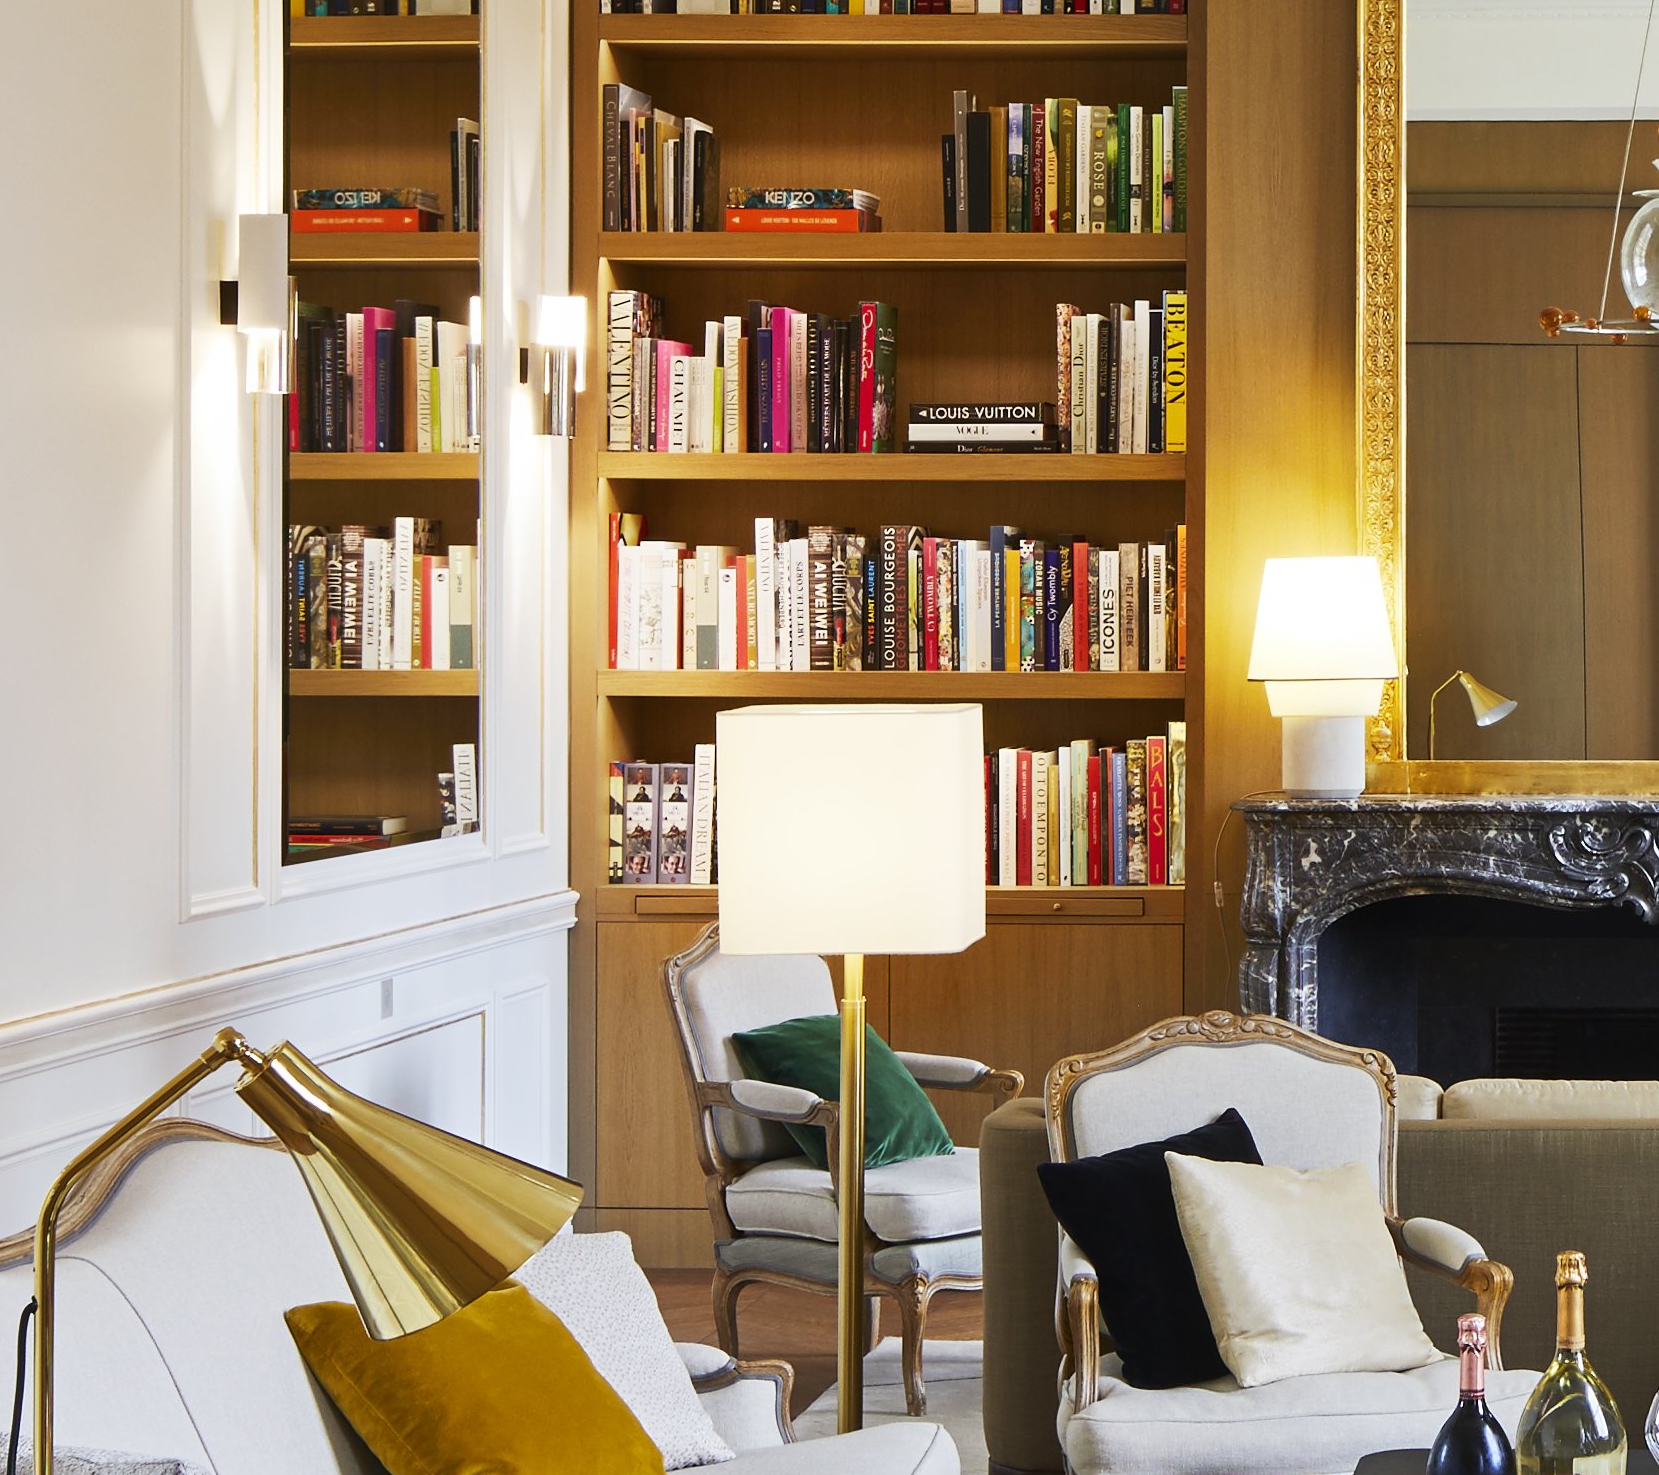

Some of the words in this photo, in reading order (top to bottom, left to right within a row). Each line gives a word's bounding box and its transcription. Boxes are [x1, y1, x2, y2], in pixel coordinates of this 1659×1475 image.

[606, 101, 616, 149] CHEVAL
[1033, 119, 1043, 134] The
[1177, 93, 1187, 154] HAMPTONS
[1033, 136, 1043, 155] New
[606, 156, 616, 198] BLANC
[1033, 158, 1043, 184] English
[1093, 151, 1105, 190] ROSE
[1177, 157, 1187, 209] GARDENS
[765, 191, 816, 205] KENZO
[1033, 186, 1043, 216] Garden
[611, 299, 631, 419] VALENTINO
[823, 361, 831, 370] LA
[1073, 343, 1084, 367] Dior
[1166, 303, 1185, 404] BEATON
[672, 359, 685, 450] CHAUMET
[726, 379, 739, 434] FASHION
[929, 406, 970, 420] LOUIS
[974, 406, 1036, 420] VUITTON
[1073, 371, 1084, 417] Christian
[956, 426, 989, 436] VOGUE
[957, 445, 973, 453] Dior
[760, 525, 771, 592] VALENTINO
[814, 561, 828, 578] AI
[884, 527, 895, 612] BOURGEOIS
[896, 527, 906, 580] INTIMES
[1035, 560, 1043, 586] ZORAN
[797, 594, 804, 603] LE
[832, 568, 847, 611] MUCHA
[1035, 589, 1043, 615] MUSIC
[1047, 566, 1058, 606] Twombly
[1125, 576, 1133, 598] PIET
[797, 609, 804, 619] ET
[814, 583, 828, 645] WEIWEI
[994, 620, 1000, 628] LA
[1047, 609, 1058, 621] Cy
[1102, 589, 1115, 655] ICONES
[1125, 601, 1133, 625] HEIN
[884, 618, 895, 669] LOUISE
[1125, 628, 1133, 647] EEK
[698, 755, 710, 813] ITALIAN
[1149, 746, 1165, 836] BALS
[1036, 757, 1047, 882] OITOEMPONTO
[696, 819, 708, 873] DREAM
